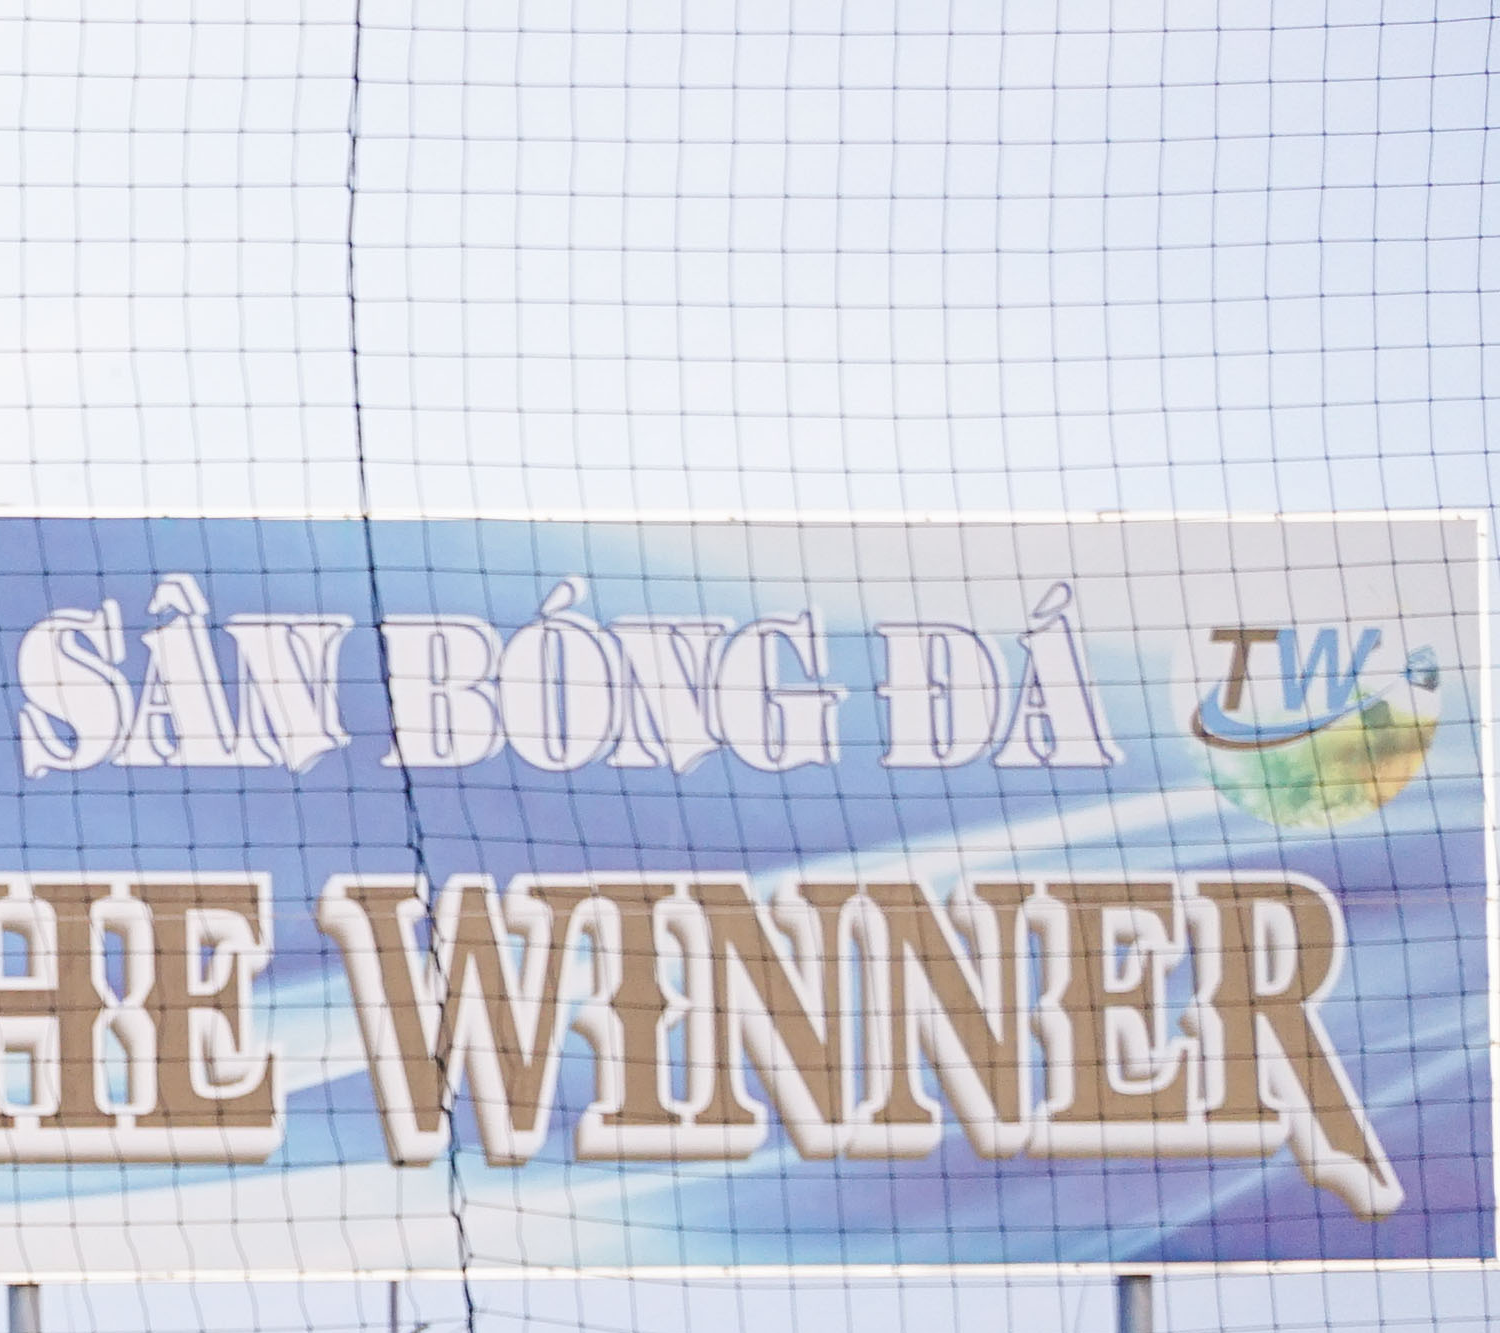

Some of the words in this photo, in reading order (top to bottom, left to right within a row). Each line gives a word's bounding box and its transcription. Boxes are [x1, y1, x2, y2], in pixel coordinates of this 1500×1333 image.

[17, 572, 350, 780] SÂN
[379, 578, 844, 777] BÓNG
[877, 579, 1124, 772] ĐÁ
[1209, 628, 1382, 711] TW
[318, 869, 1403, 1218] WINNER
